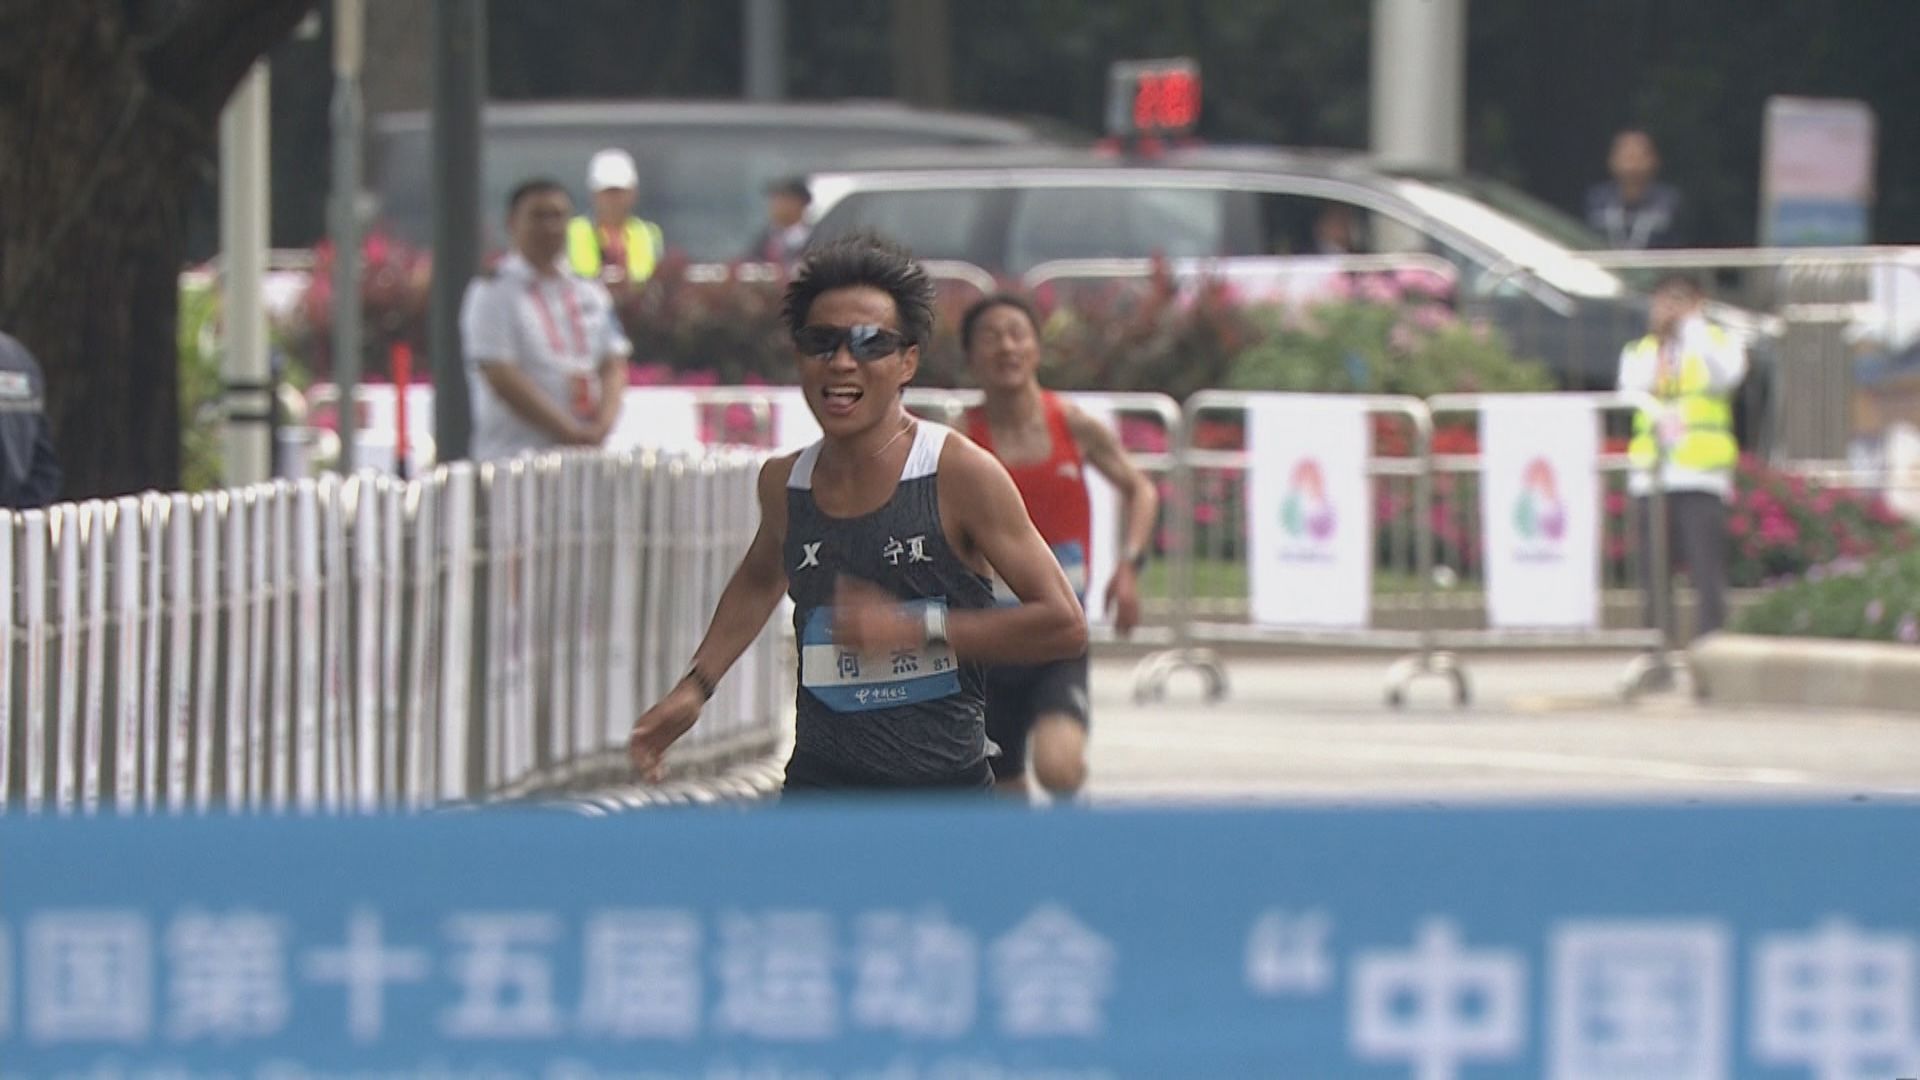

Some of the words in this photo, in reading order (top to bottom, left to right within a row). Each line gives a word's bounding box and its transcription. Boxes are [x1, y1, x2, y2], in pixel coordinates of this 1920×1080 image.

[883, 534, 933, 566] 宁夏
[933, 656, 950, 672] 81
[0, 903, 1116, 1042] 国第十五届运动会
